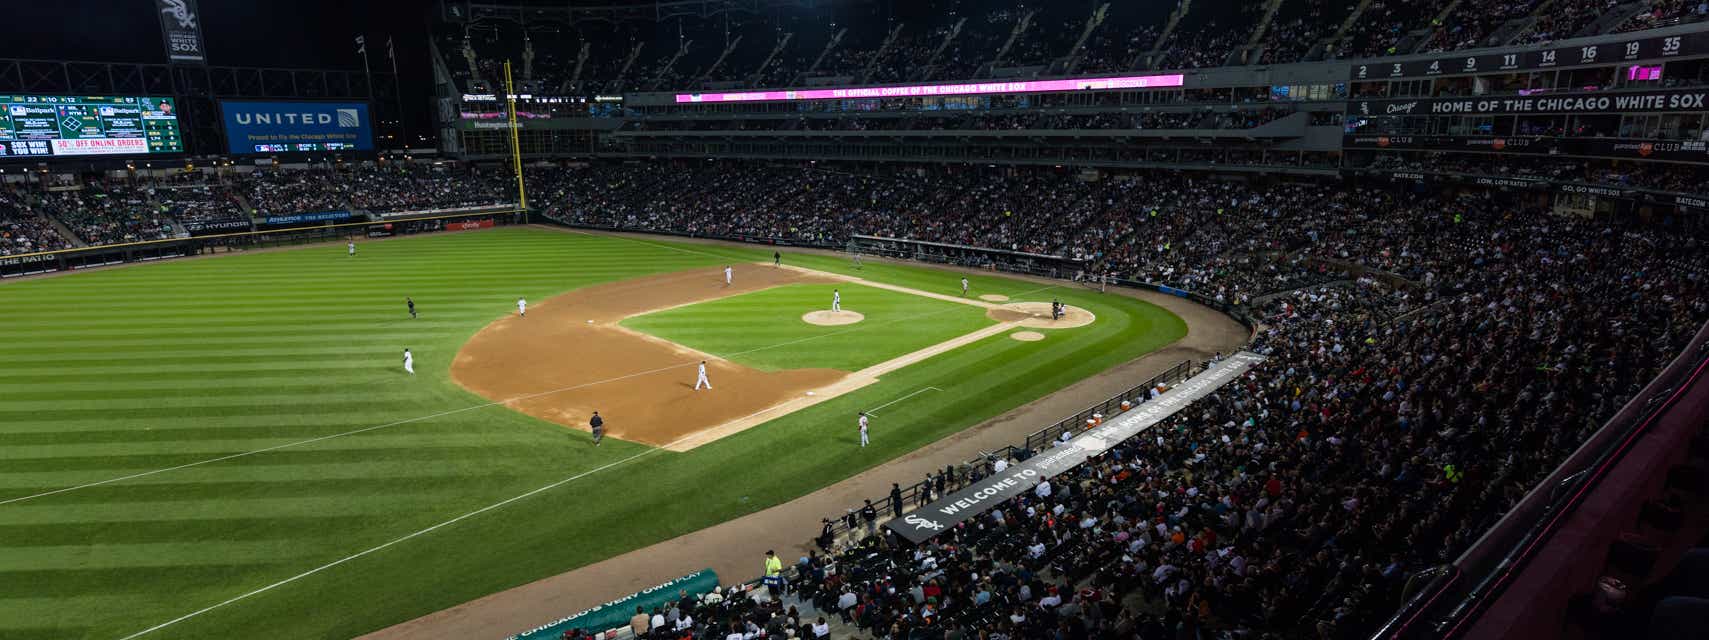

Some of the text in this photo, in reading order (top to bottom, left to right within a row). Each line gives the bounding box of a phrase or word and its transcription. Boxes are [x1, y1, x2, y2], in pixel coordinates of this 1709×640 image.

[171, 43, 200, 52] SOX
[1625, 42, 1640, 55] 19
[1662, 37, 1681, 51] 35
[1541, 50, 1556, 62] 14
[1581, 46, 1597, 59] 16
[1430, 60, 1439, 71] 4
[1467, 57, 1476, 68] 9
[1503, 54, 1517, 66] 11
[1359, 65, 1367, 75] 2
[1392, 63, 1401, 73] 3
[833, 82, 1027, 98] THE OFFICIAL COFFEE OF THE CHICAGO WHITE SOX
[1385, 101, 1418, 115] Chicago
[1431, 92, 1706, 113] HOME OF THE CHICAGO WHITE SOX
[26, 106, 56, 114] Ballpark
[235, 112, 334, 125] UNITED
[301, 132, 325, 141] Chicago
[1390, 136, 1413, 144] CLUB
[1507, 138, 1530, 146] CLUB
[11, 140, 48, 149] SOX WIN!
[75, 140, 89, 148] OFF
[90, 140, 117, 148] ONLINE
[118, 139, 145, 147] ORDERS
[1653, 143, 1681, 152] CLUB
[12, 147, 29, 155] YOU
[30, 147, 50, 155] WIN!
[1562, 184, 1620, 197] GO, GO WHITE SOX
[1676, 197, 1706, 208] RATE.COM
[205, 221, 250, 231] HYUNDAI
[0, 253, 56, 267] THE PATIO
[939, 477, 1019, 516] WELCOME
[1015, 468, 1038, 484] TO
[520, 605, 604, 637] CHICAGO'S
[605, 592, 641, 609] VERY
[642, 578, 674, 595] OWN
